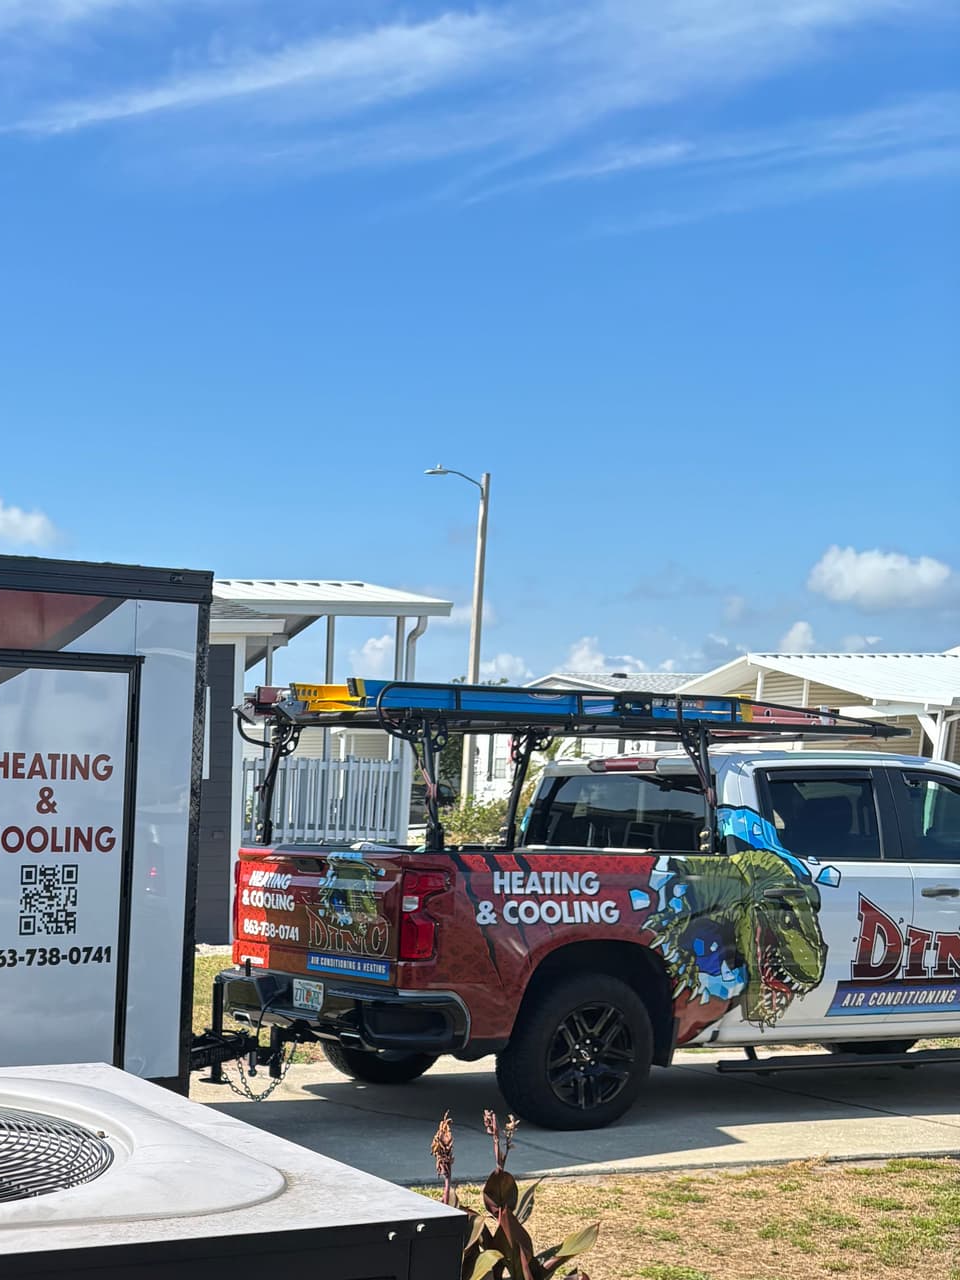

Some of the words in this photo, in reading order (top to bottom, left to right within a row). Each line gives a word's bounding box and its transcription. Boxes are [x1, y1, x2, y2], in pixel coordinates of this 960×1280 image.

[36, 786, 58, 814] &
[250, 870, 292, 890] HEATING
[494, 871, 600, 896] HEATING
[242, 889, 251, 905] &
[251, 893, 295, 911] COOLING
[476, 901, 498, 925] &
[503, 900, 620, 925] COOLING
[244, 919, 299, 941] 863-738-0741
[305, 904, 389, 958] DINO
[310, 955, 319, 966] AIR
[320, 956, 356, 971] CONDITIONING
[363, 962, 387, 975] HEATING
[842, 993, 866, 1008] AIR
[868, 990, 957, 1006] CONDITIONING
